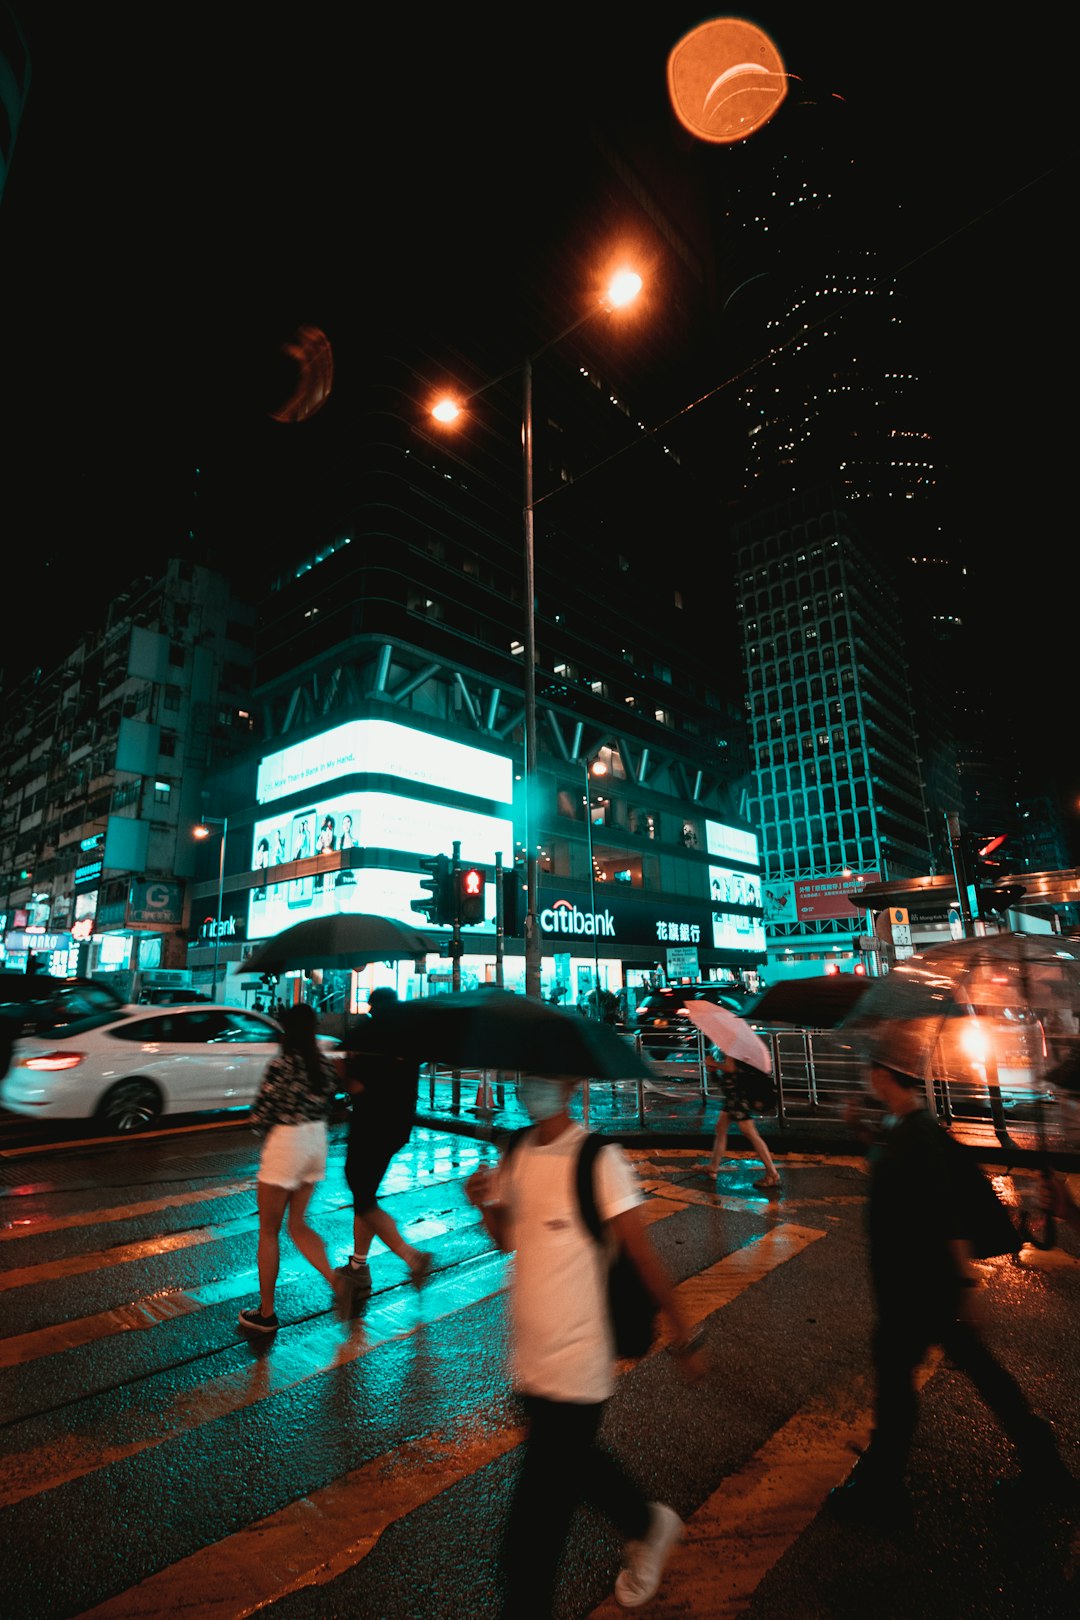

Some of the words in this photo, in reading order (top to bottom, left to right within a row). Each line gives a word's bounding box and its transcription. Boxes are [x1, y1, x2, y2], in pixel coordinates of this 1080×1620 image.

[146, 885, 169, 908] G
[540, 900, 616, 937] citibank
[22, 934, 57, 949] wanko
[656, 920, 700, 943] 花旗銀行
